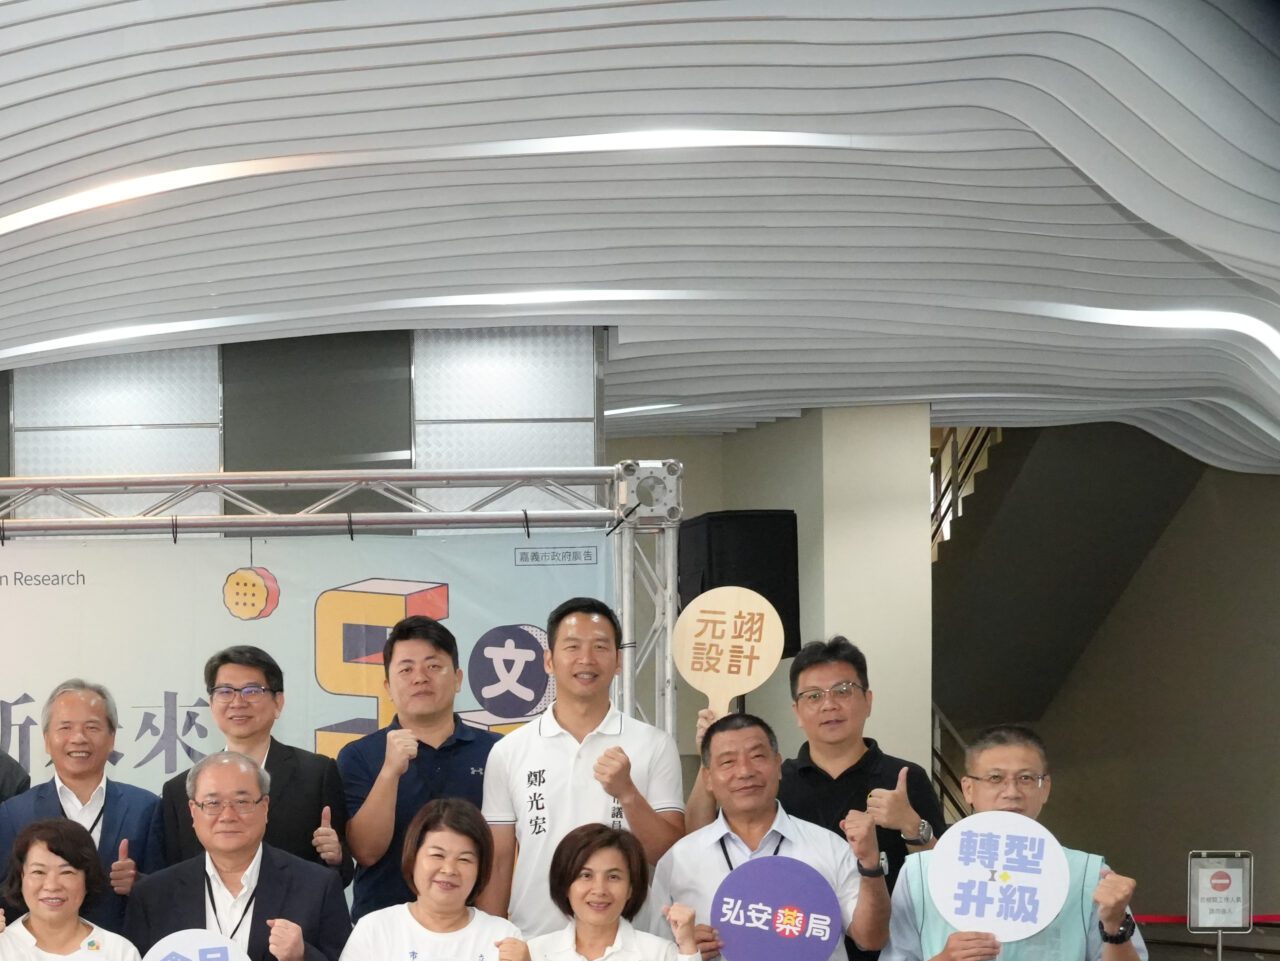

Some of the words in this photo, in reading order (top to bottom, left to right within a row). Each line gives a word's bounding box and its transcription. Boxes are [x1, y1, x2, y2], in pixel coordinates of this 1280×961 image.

[13, 570, 86, 587] Research
[481, 639, 536, 701] 文
[690, 642, 761, 676] 設計
[526, 769, 547, 835] 鄭光宏
[957, 829, 1045, 876] 轉型
[953, 878, 1040, 925] 升級
